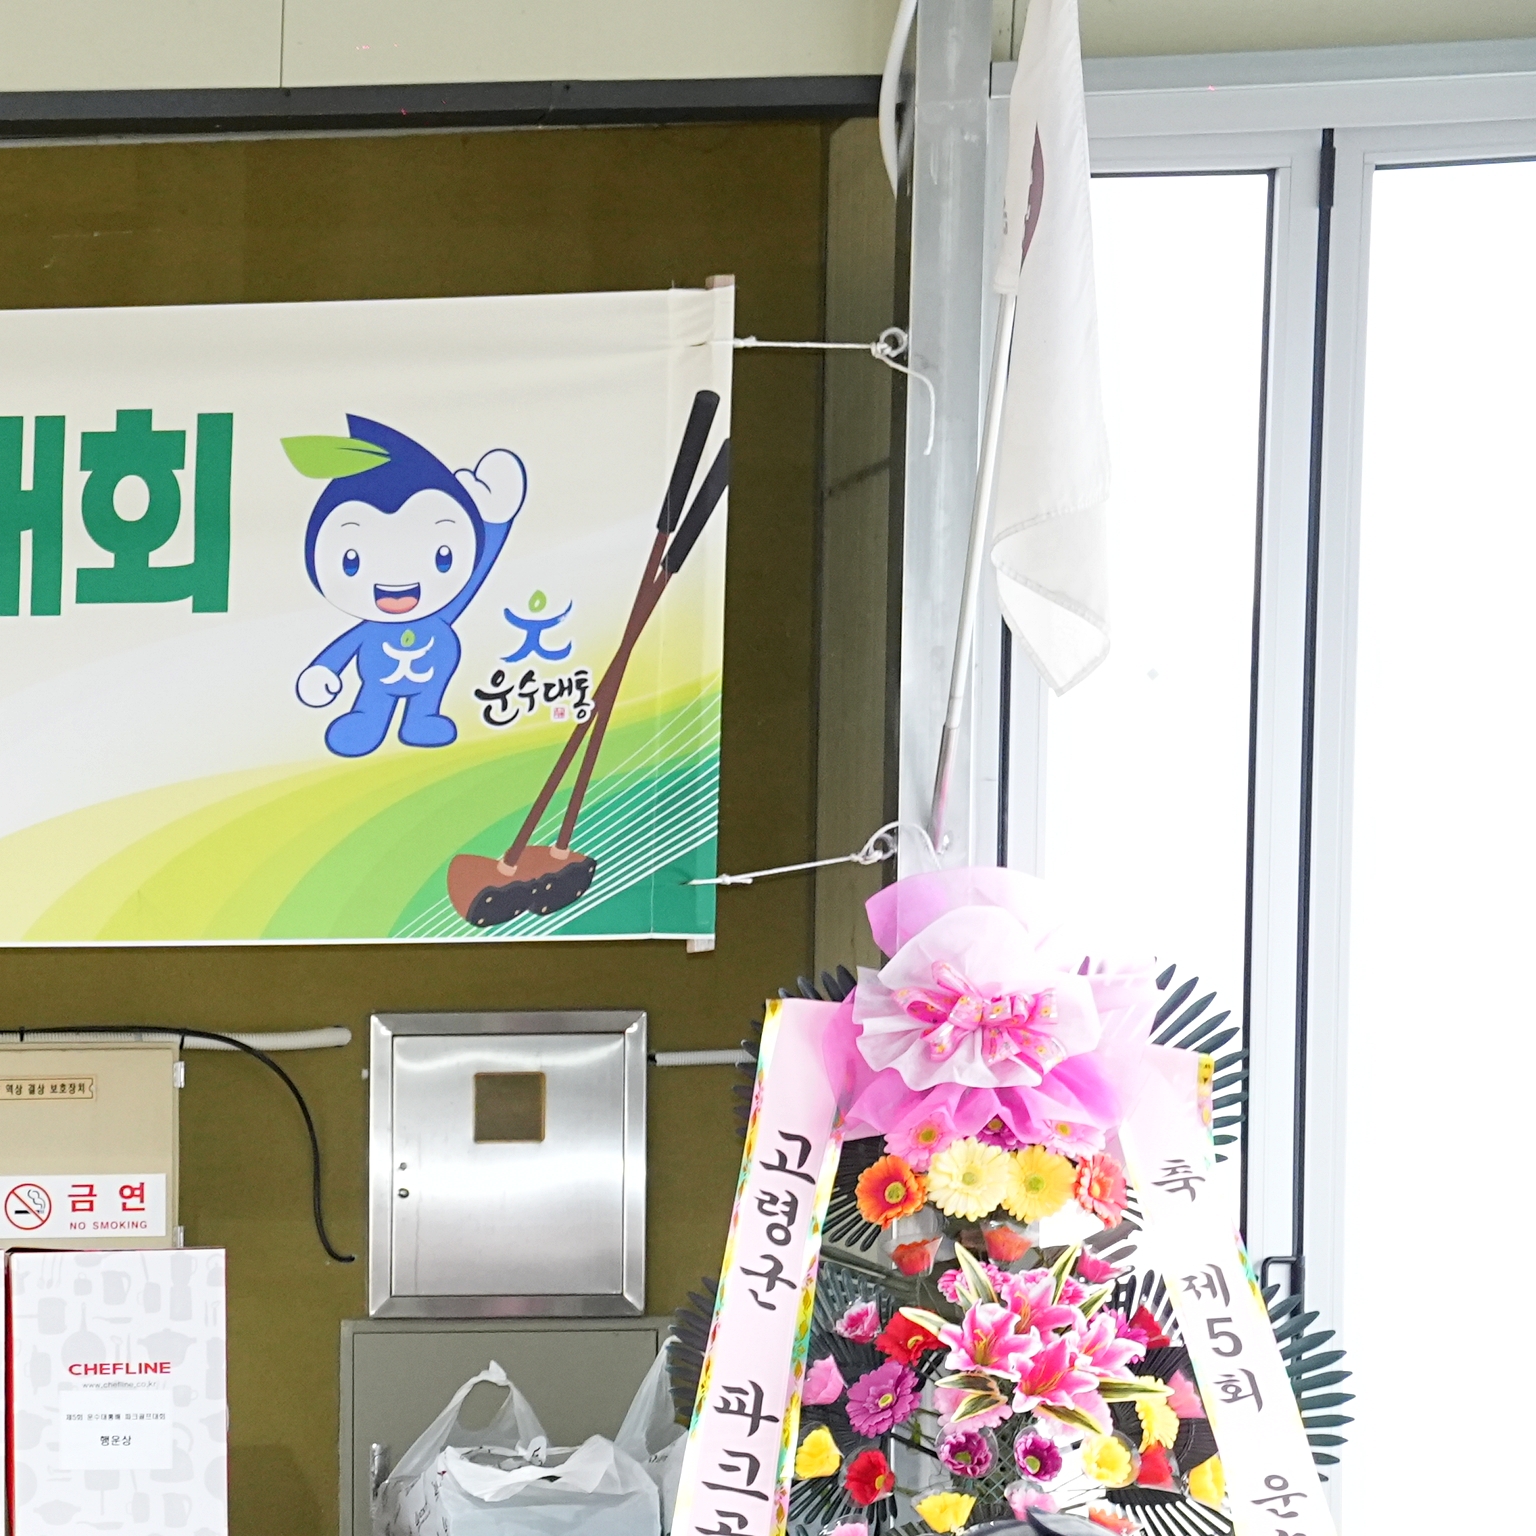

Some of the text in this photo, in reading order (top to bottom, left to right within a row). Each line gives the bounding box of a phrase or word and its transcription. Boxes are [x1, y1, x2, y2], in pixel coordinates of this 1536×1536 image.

[474, 669, 590, 726] 운수대통
[50, 1083, 86, 1095] 보호장치
[1150, 1159, 1206, 1203] 축
[69, 1221, 148, 1230] NO SMOKING
[738, 1129, 816, 1312] 고령군
[1180, 1263, 1264, 1413] 제5회
[68, 1361, 172, 1376] CHEFLINE
[82, 1381, 156, 1389] www.chefline.co.kr
[100, 1435, 132, 1447] 행운상
